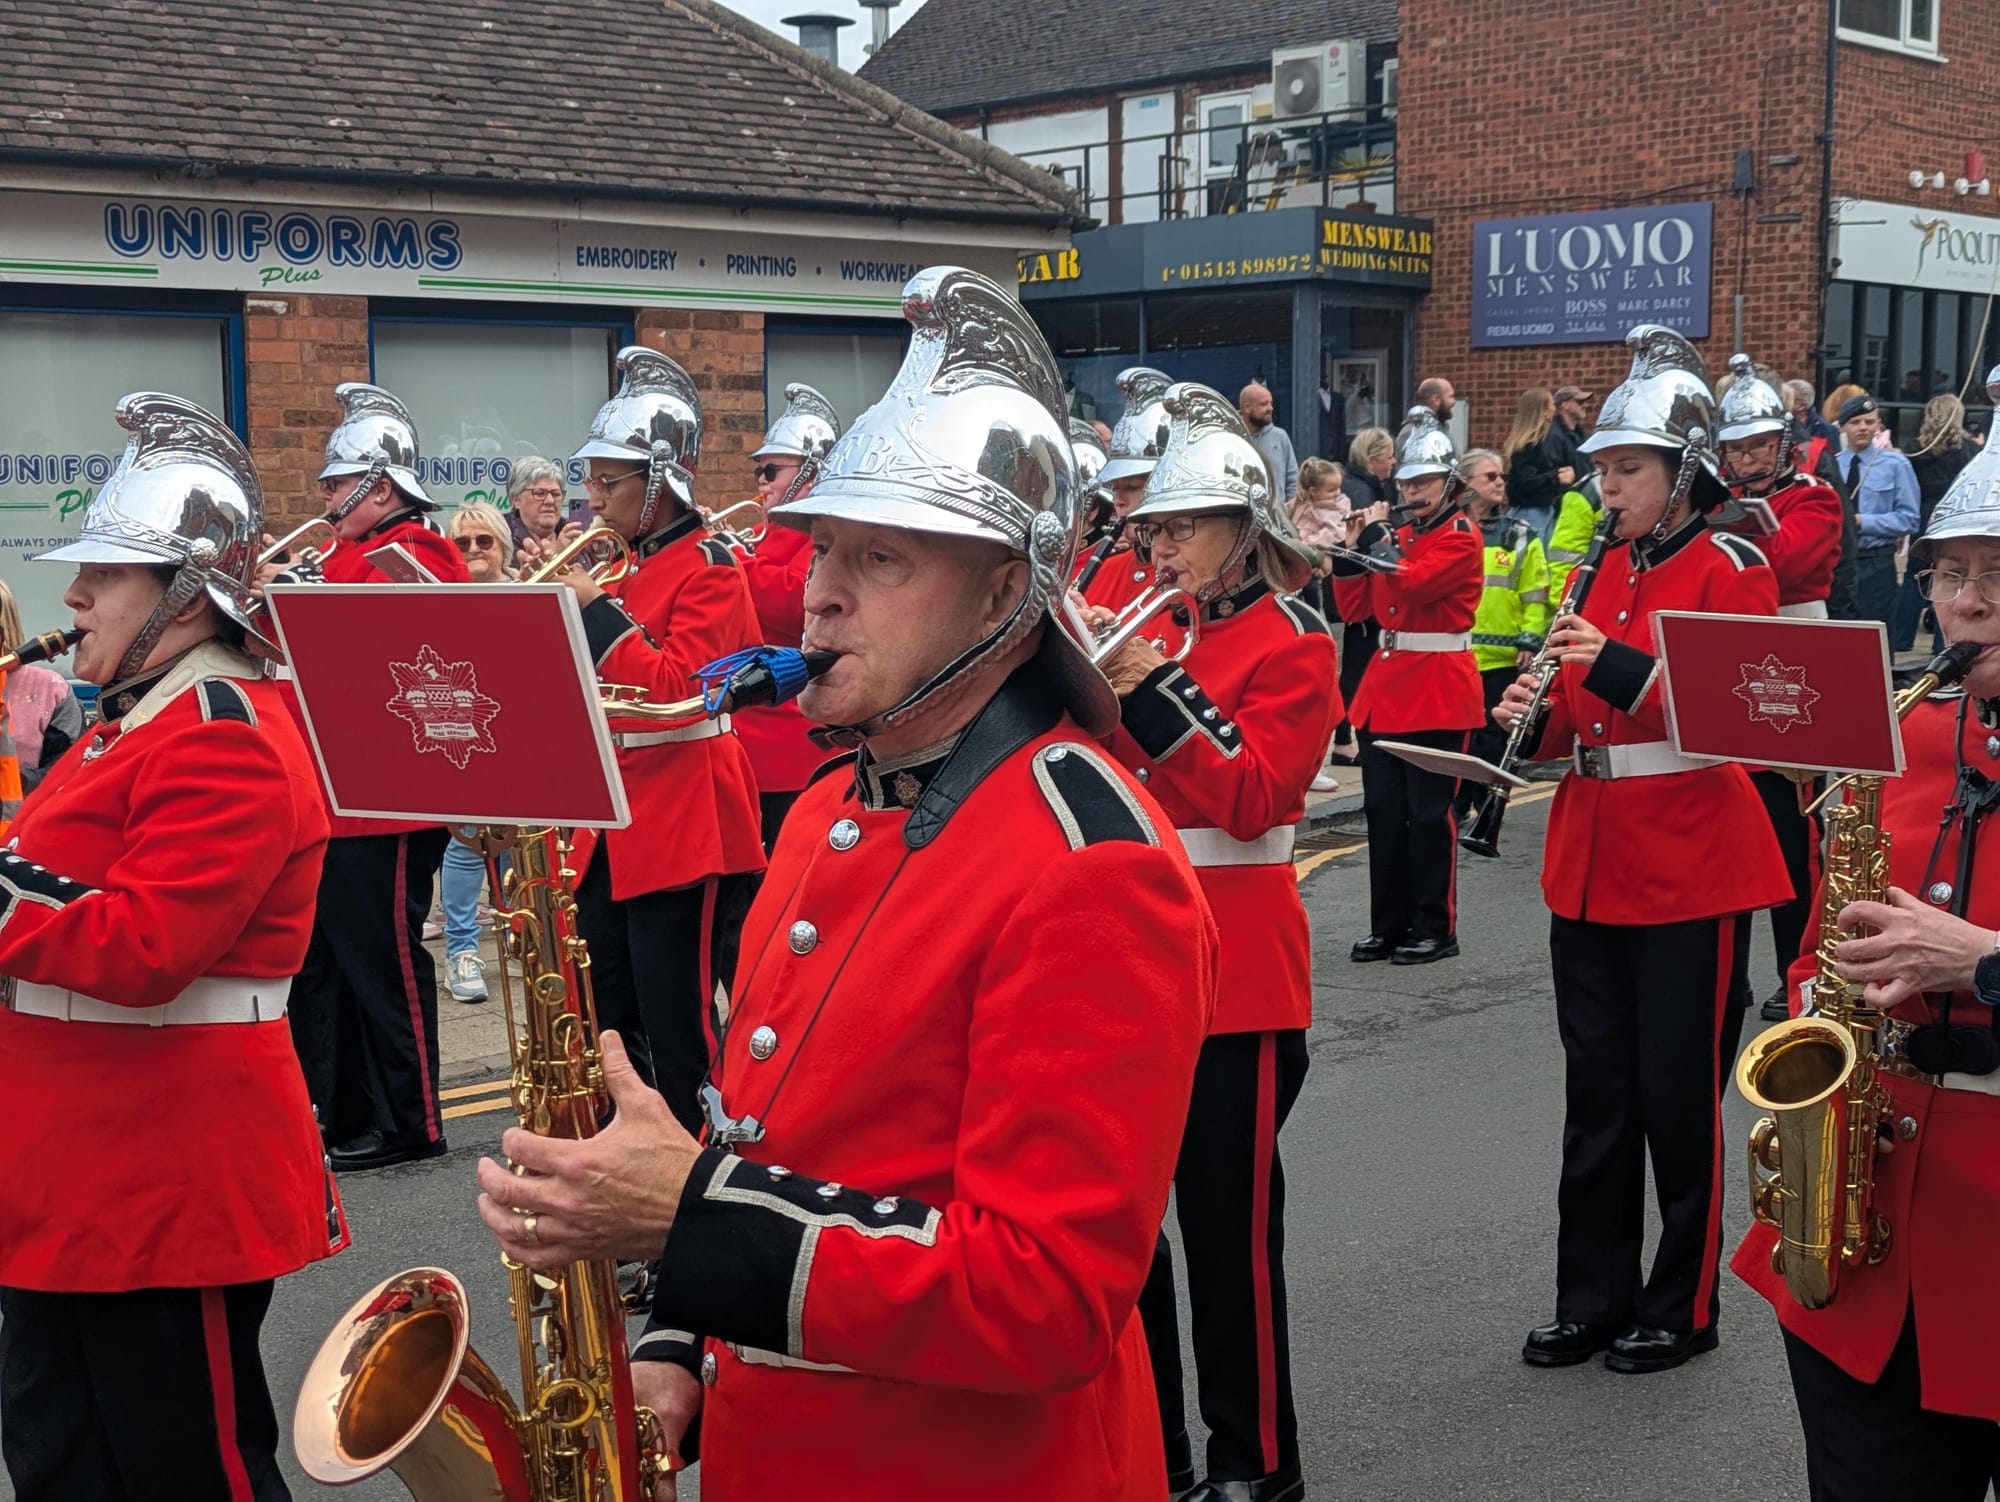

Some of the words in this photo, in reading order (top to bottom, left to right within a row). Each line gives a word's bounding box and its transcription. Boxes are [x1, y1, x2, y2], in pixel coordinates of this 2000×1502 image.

[105, 203, 463, 271] UNIFORMS
[1322, 219, 1432, 255] MENSWEAR
[1488, 218, 1694, 277] L'UOMO
[576, 246, 678, 271] EMBROIDERY
[727, 254, 797, 278] PRINTING
[1241, 254, 1311, 275] 898972
[1320, 248, 1386, 270] WEDDING
[1388, 254, 1430, 274] SUITS
[259, 266, 323, 288] Plus
[1486, 266, 1693, 298] MENSWEAR
[1564, 298, 1608, 314] BOSS
[1617, 298, 1649, 312] MARC
[1653, 296, 1692, 310] DARCY
[1486, 324, 1521, 337] REMUS
[1521, 322, 1554, 336] UOMO
[418, 457, 586, 485] NIFOS
[55, 487, 93, 523] Pl
[1, 537, 45, 548] ALWAYS
